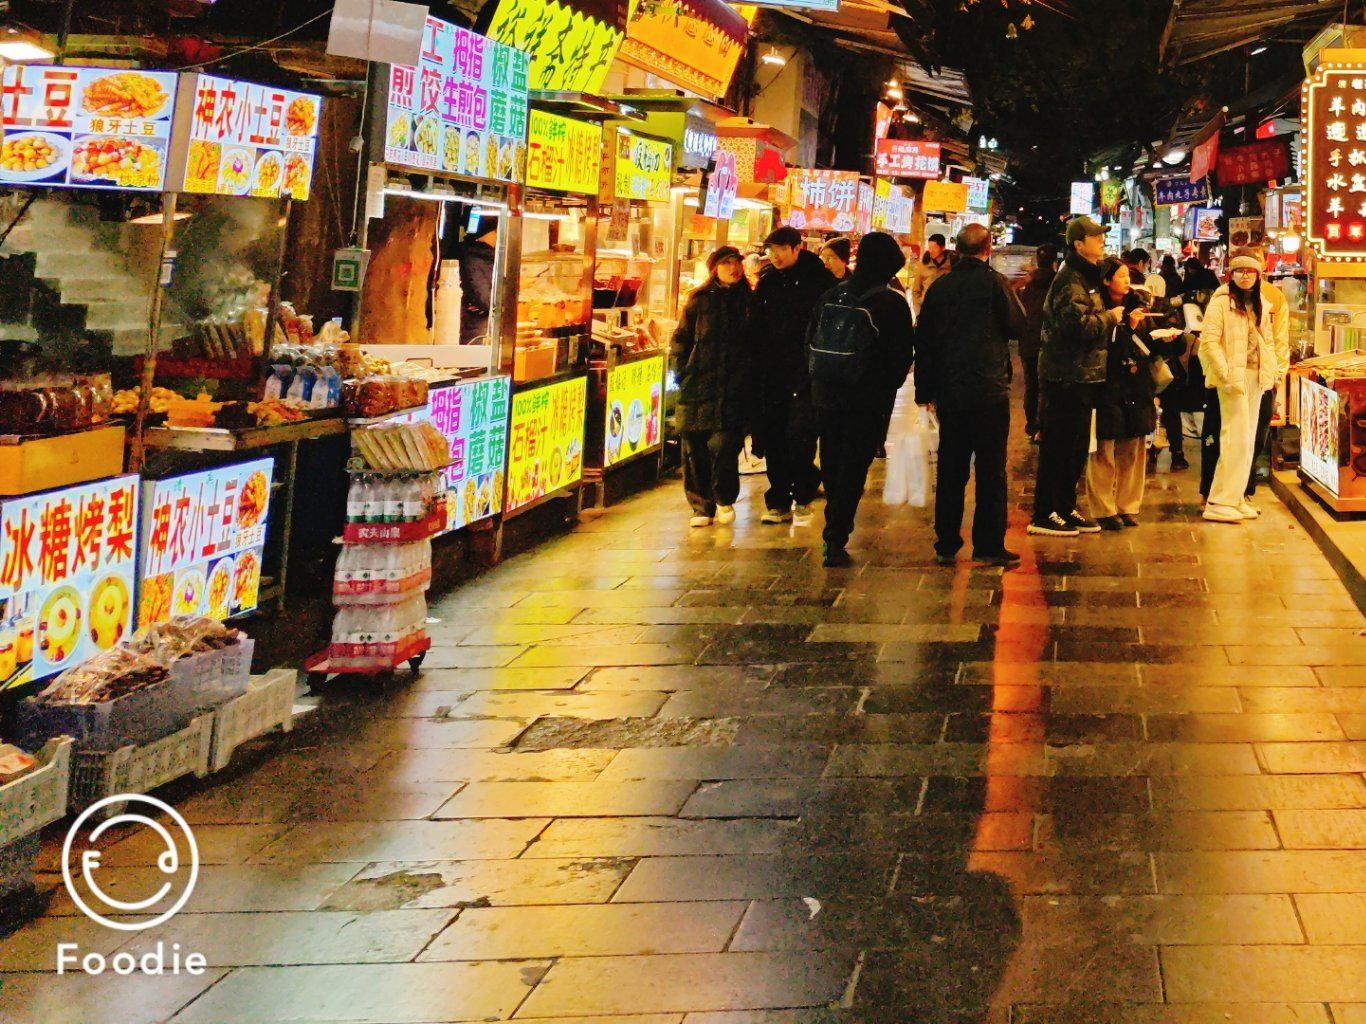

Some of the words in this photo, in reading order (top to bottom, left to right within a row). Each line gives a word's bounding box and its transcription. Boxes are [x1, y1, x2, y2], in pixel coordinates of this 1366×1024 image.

[453, 28, 484, 81] 拇指
[492, 43, 529, 93] 椒盐
[194, 77, 286, 146] 神农小土豆
[390, 62, 442, 116] 煎饺
[440, 78, 488, 130] 生煎包
[90, 118, 156, 136] 狼牙土豆
[470, 378, 508, 429] 椒盐
[1, 483, 135, 593] 冰糖烤梨
[149, 479, 239, 577] 神农小土豆
